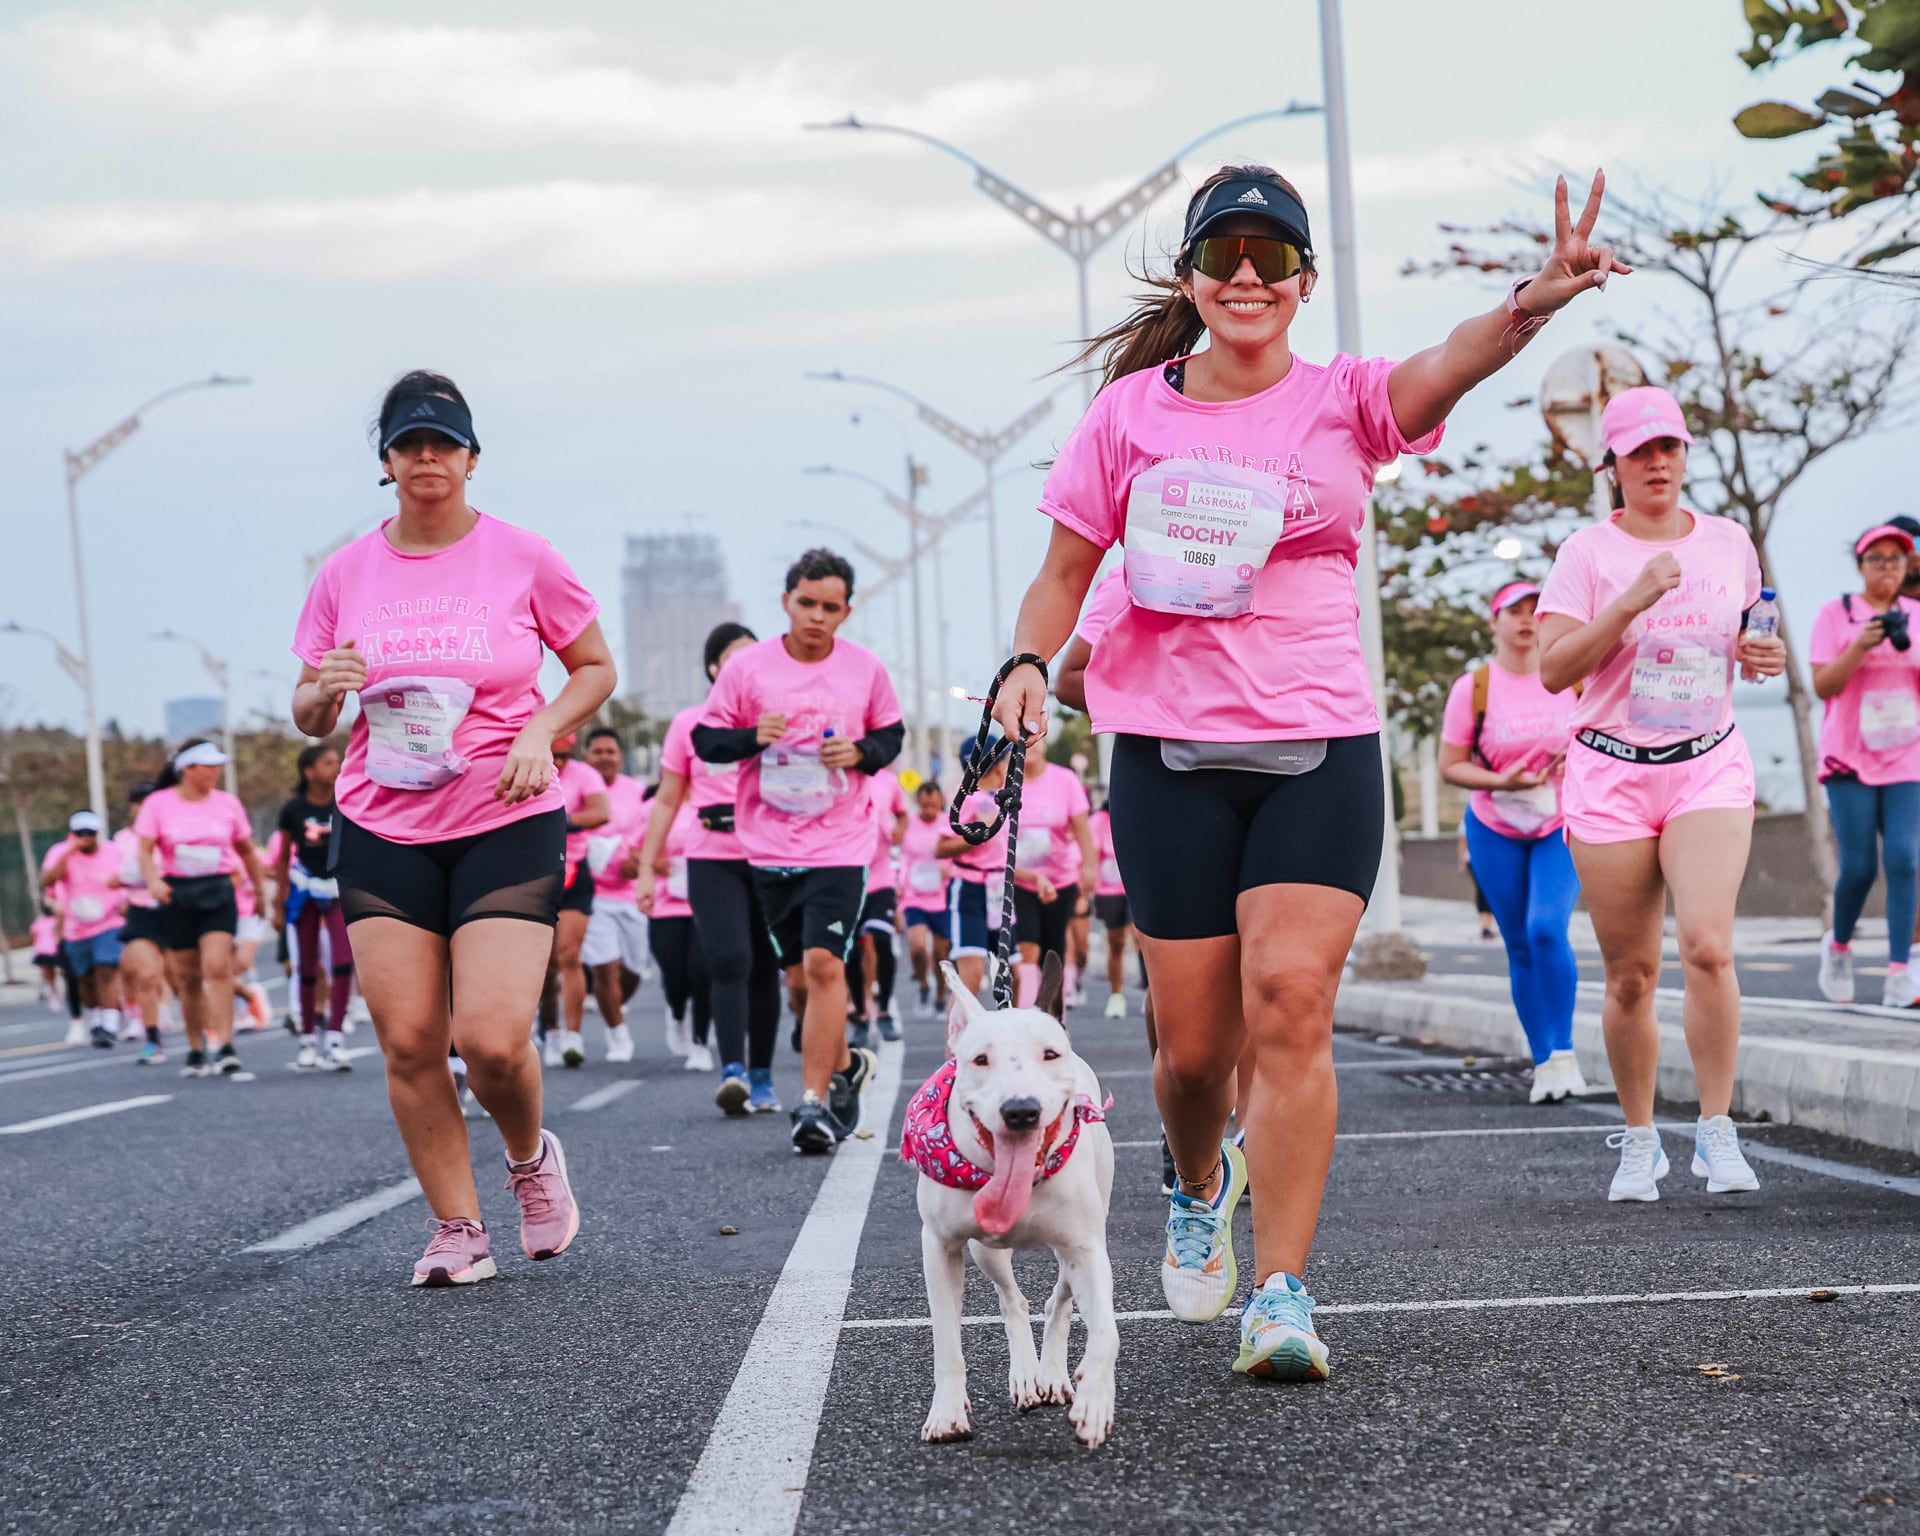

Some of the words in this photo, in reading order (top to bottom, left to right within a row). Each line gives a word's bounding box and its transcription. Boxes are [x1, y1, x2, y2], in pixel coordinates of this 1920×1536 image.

[1237, 197, 1268, 206] adidas
[1151, 445, 1304, 474] CRRERA
[1193, 487, 1232, 497] CARRERA
[1192, 495, 1211, 506] LAS
[1212, 497, 1247, 511] ROSAS
[1161, 508, 1183, 518] Corro
[1183, 512, 1198, 520] con
[1207, 514, 1227, 524] alma
[1228, 518, 1242, 527] por
[1242, 519, 1248, 527] ti
[1167, 522, 1238, 546] ROCHY
[1183, 550, 1216, 567] 10869
[360, 595, 490, 629] CARRERA
[1646, 613, 1708, 630] ROSAS
[362, 626, 493, 668] ALMA
[382, 636, 458, 655] ROSAS
[1668, 674, 1696, 687] ANY
[403, 722, 432, 736] TERE
[408, 742, 428, 753] 12980
[1592, 733, 1637, 760] PRO
